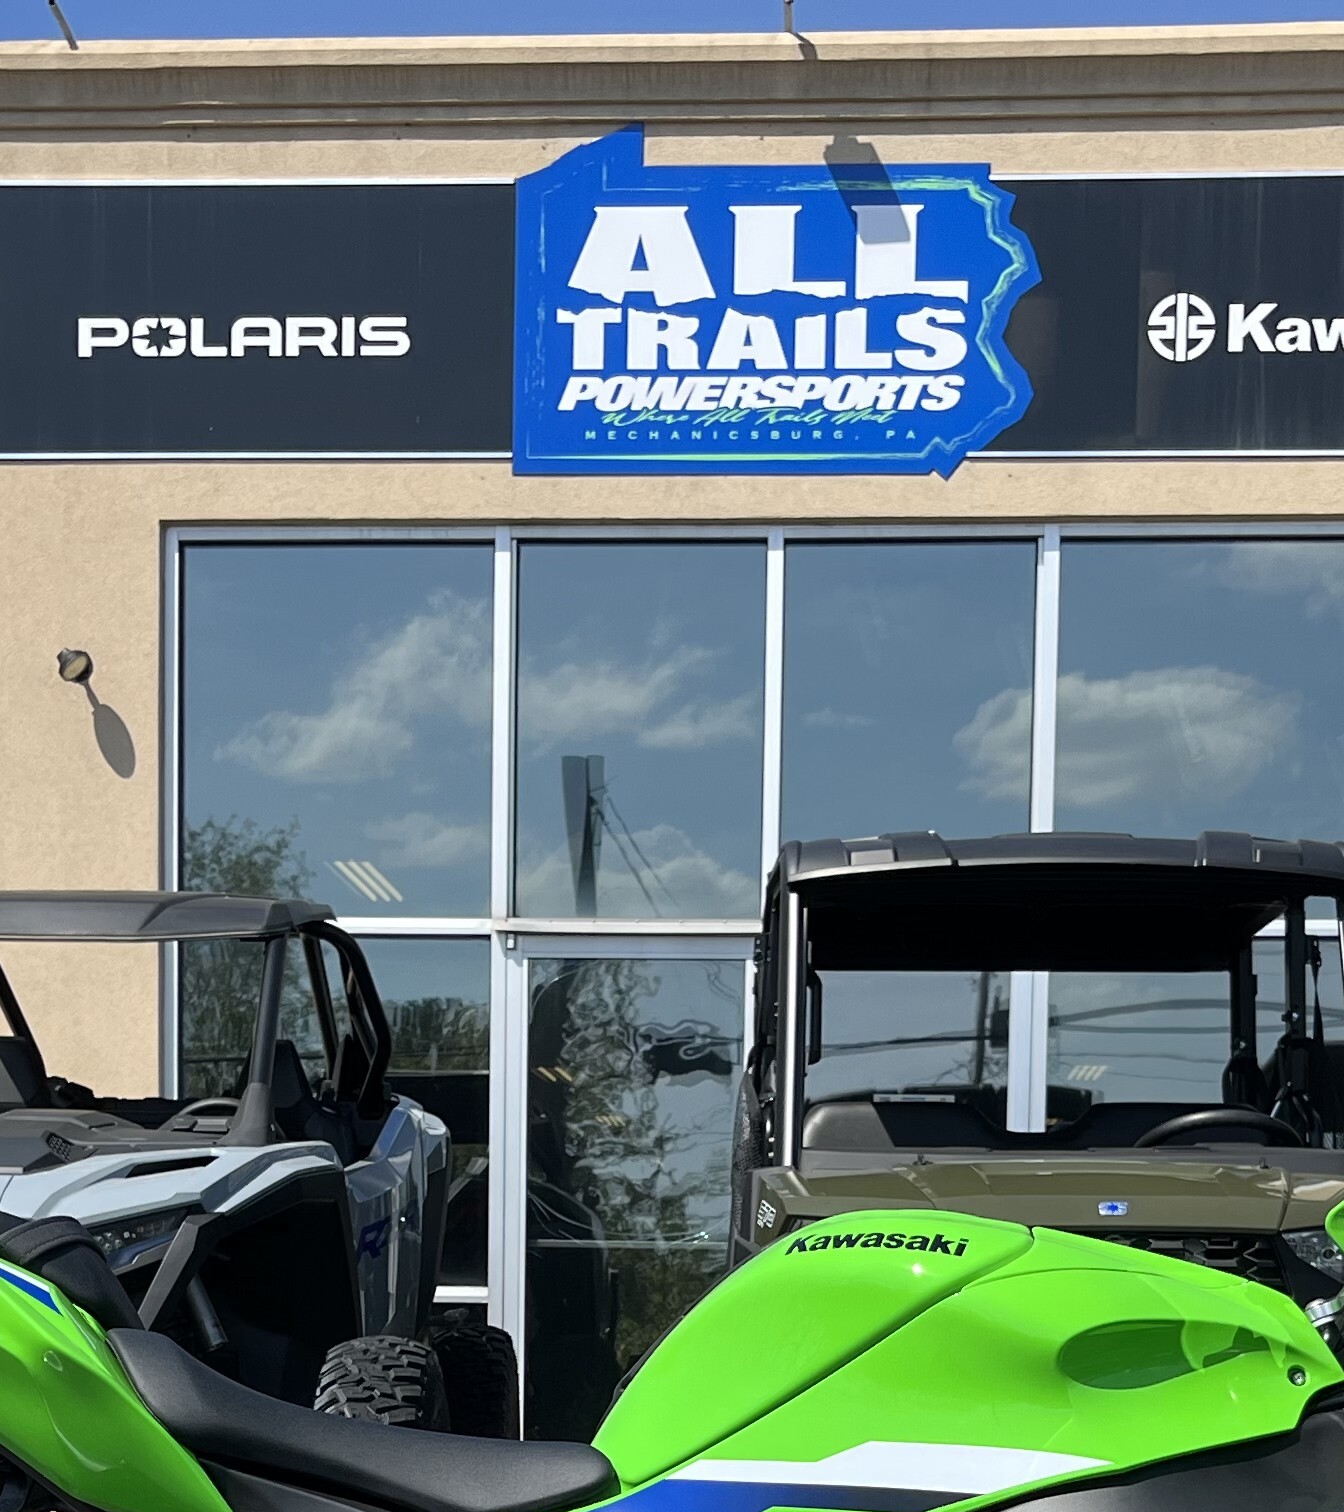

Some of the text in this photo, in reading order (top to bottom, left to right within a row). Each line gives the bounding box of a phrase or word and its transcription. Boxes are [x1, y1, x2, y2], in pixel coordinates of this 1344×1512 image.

[567, 204, 969, 306] ALL
[77, 316, 411, 358] POLARIS
[556, 307, 968, 371] TRAILS
[557, 374, 967, 412] POWERSPORTS
[601, 407, 689, 426] Where
[692, 407, 751, 426] All
[886, 430, 916, 440] PA
[784, 1231, 970, 1258] Kawasaki
